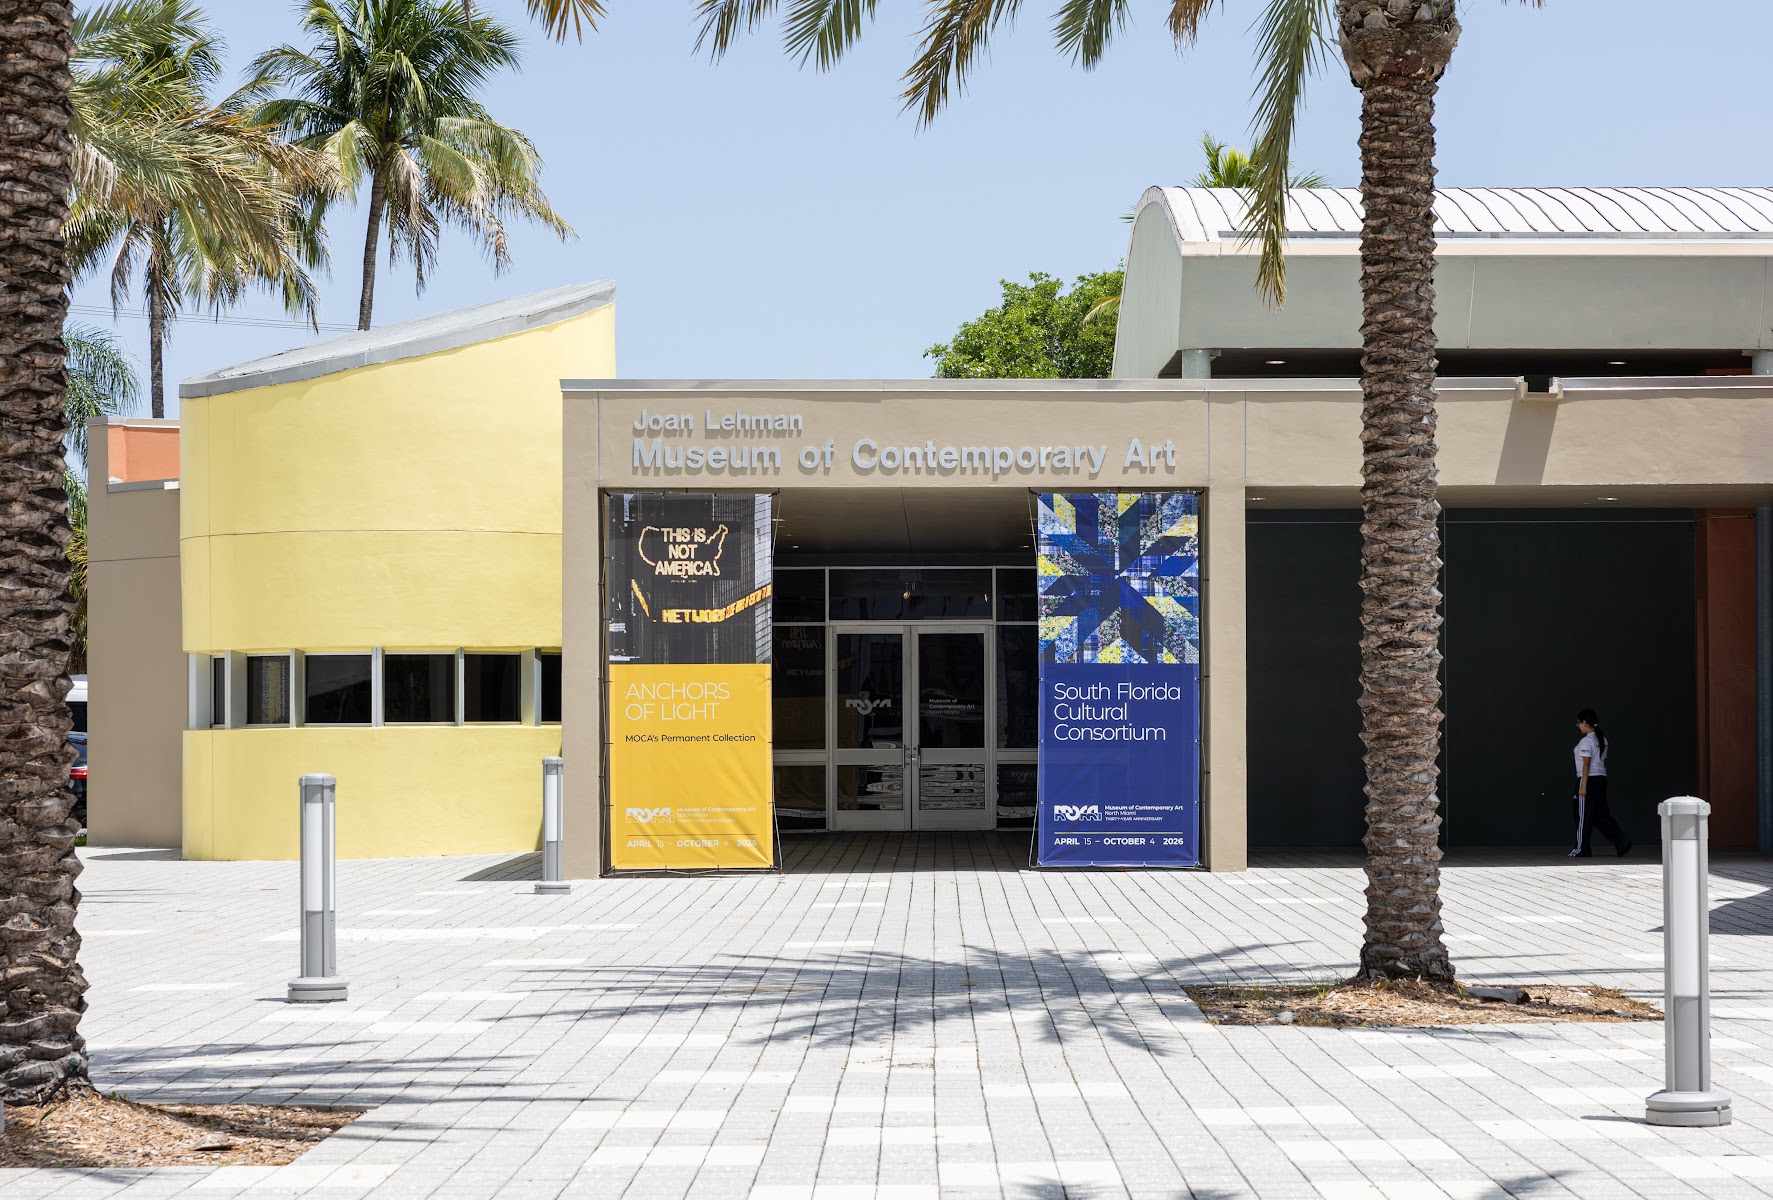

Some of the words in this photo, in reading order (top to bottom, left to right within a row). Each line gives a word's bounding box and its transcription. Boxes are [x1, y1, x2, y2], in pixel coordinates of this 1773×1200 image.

[633, 408, 694, 431] Joan
[705, 408, 803, 431] Lehman
[633, 438, 782, 469] Museum
[799, 439, 836, 469] of
[852, 438, 1108, 474] Contemporary
[1123, 438, 1176, 468] Art
[660, 527, 691, 543] THIS
[693, 527, 707, 543] IS
[668, 544, 698, 559] NOT
[655, 560, 713, 576] AMERICA
[625, 682, 730, 700] ANCHORS
[1054, 682, 1111, 700] South
[1117, 682, 1181, 700] Florida
[625, 703, 656, 721] OF
[661, 702, 720, 720] LIGHT
[1054, 702, 1128, 721] Cultural
[625, 734, 659, 743] MOCA's
[661, 734, 711, 742] Permanent
[712, 733, 756, 742] Collection
[1054, 723, 1166, 741] Consortium
[627, 840, 653, 848] APRIL
[656, 840, 665, 848] 15
[676, 839, 719, 847] OCTOBER
[723, 839, 729, 847] 4
[737, 839, 757, 847] 2026
